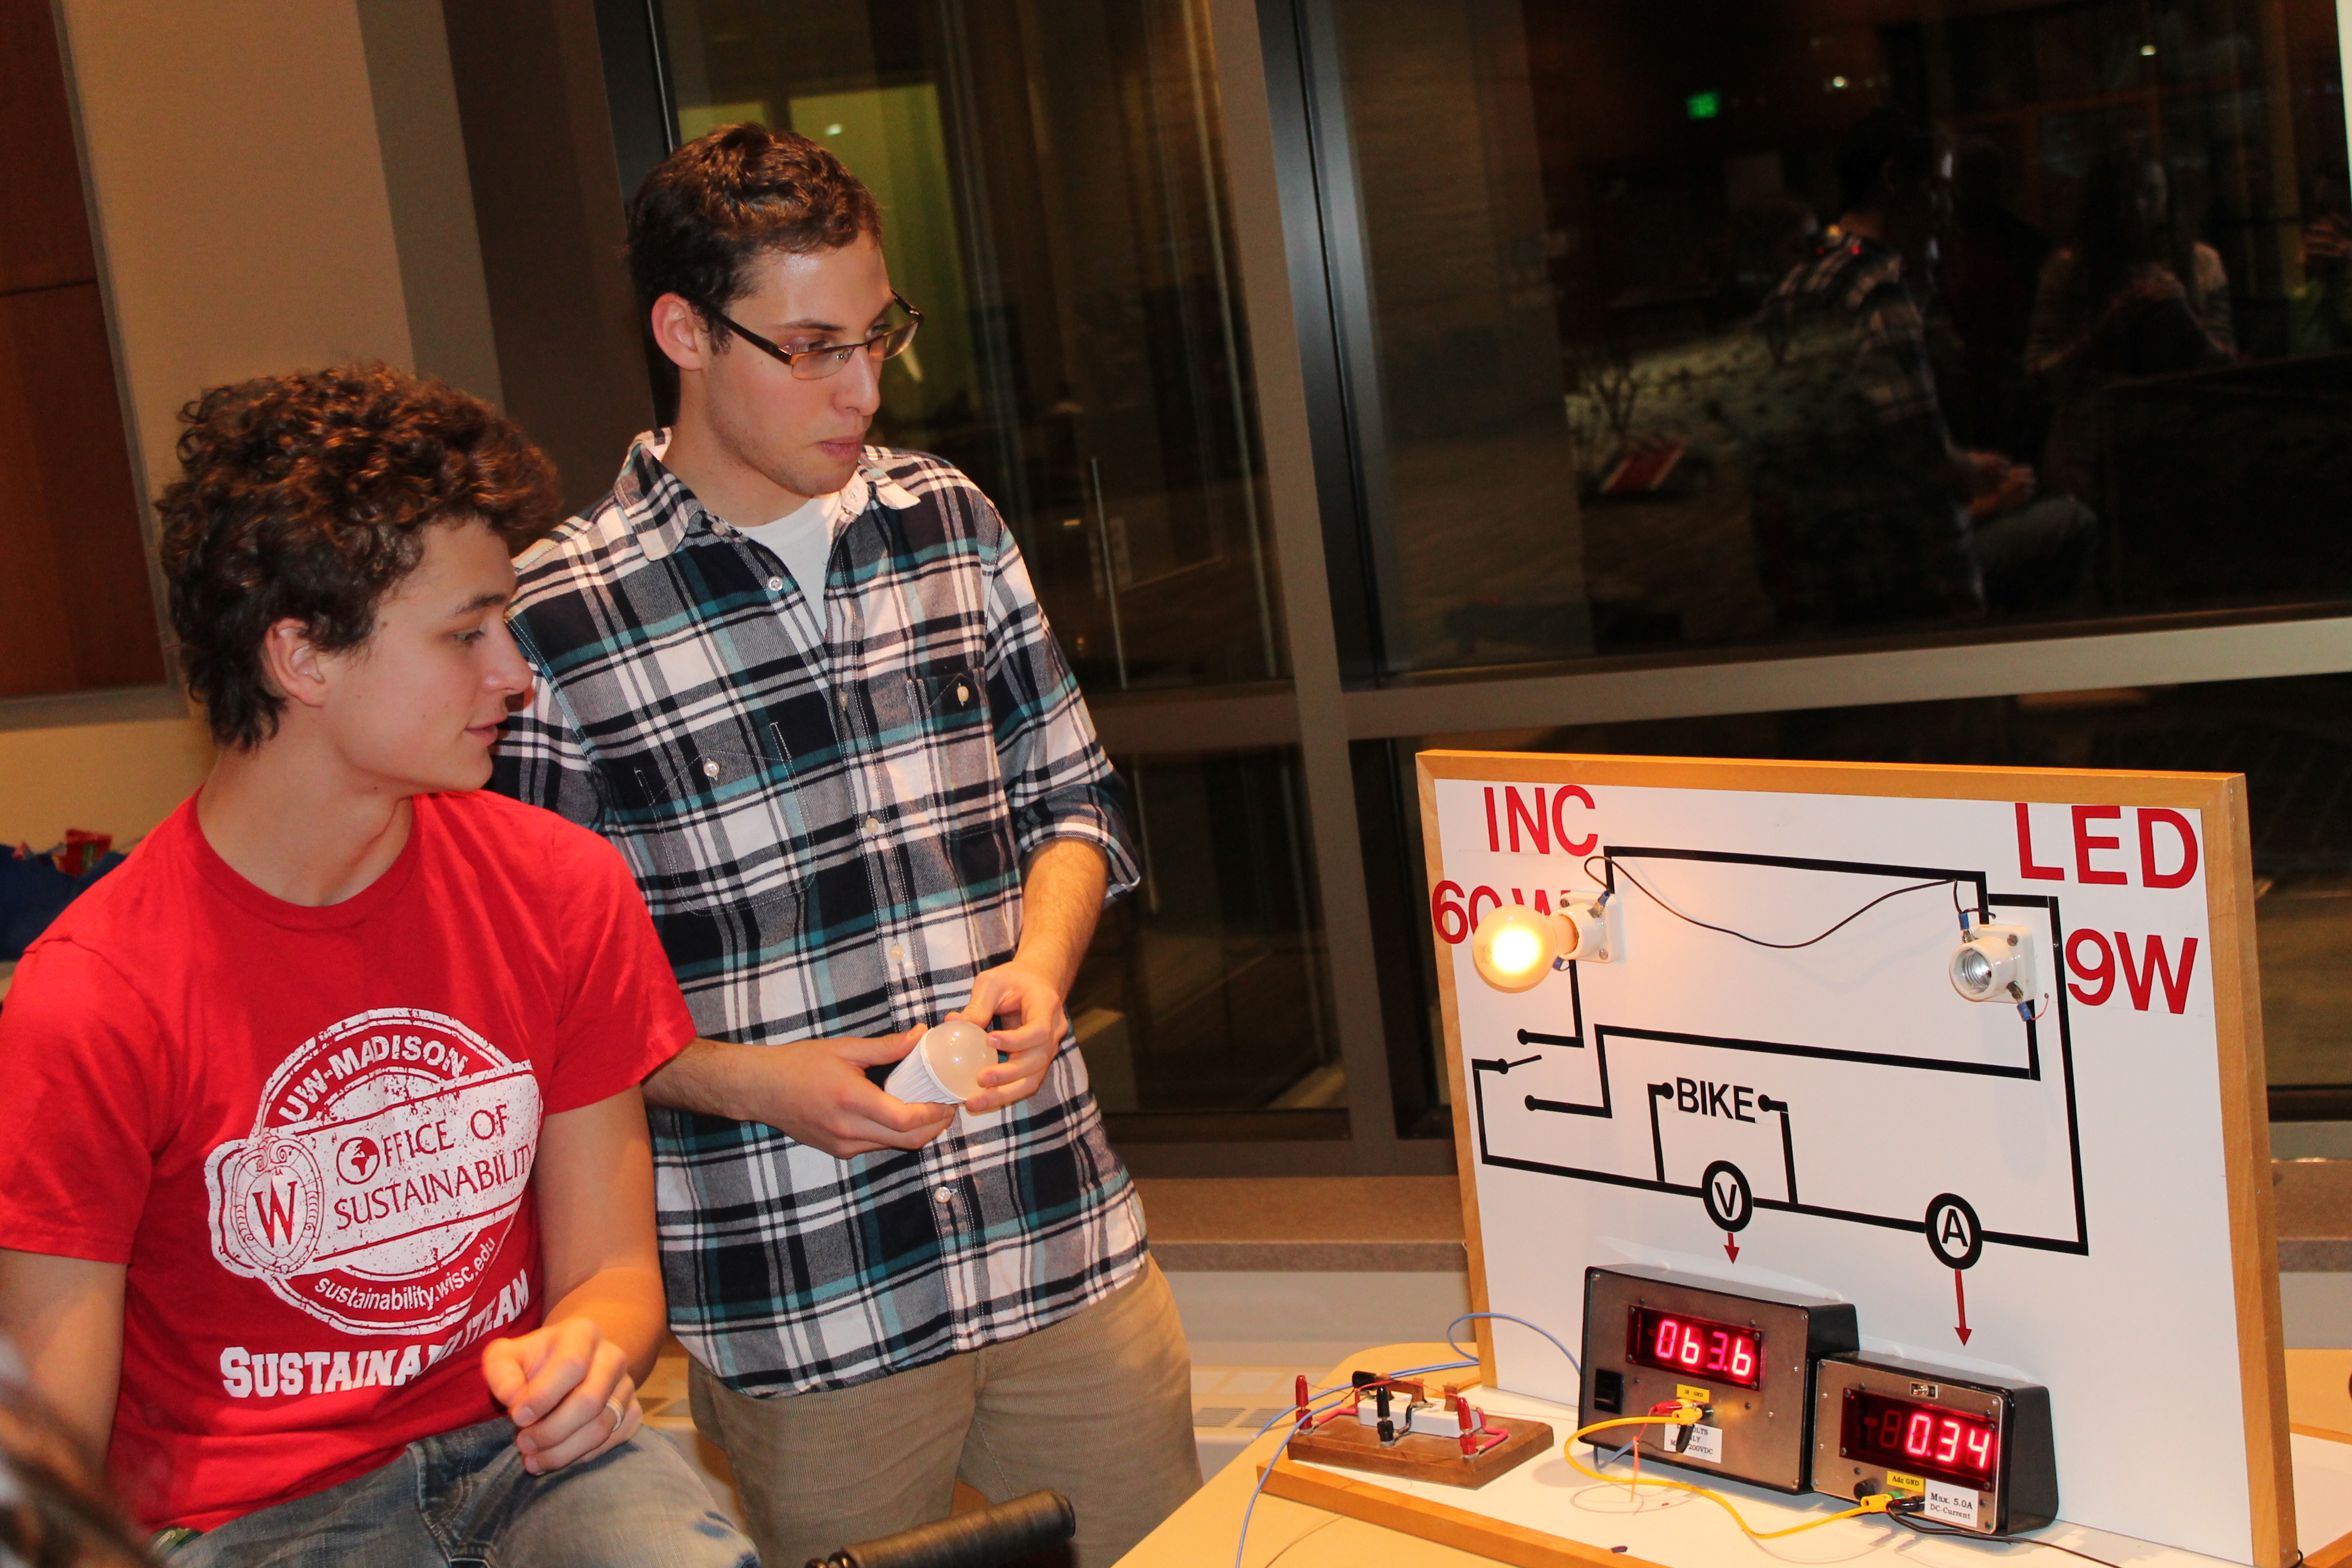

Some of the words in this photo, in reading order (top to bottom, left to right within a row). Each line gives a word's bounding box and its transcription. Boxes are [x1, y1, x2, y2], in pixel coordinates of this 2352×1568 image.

[1484, 785, 1598, 857] INC
[2015, 802, 2198, 889] LED
[2065, 928, 2198, 1015] 9W
[278, 1035, 469, 1122] UW-MADISON
[1676, 1077, 1756, 1124] BIKE
[470, 1103, 508, 1140] OF
[334, 1139, 537, 1231] SUSTAINABILITY
[1714, 1182, 1738, 1218] V
[252, 1178, 298, 1248] W
[1941, 1208, 1969, 1247] A
[315, 1237, 496, 1311] sustainability.wisc.edu
[1907, 1414, 1990, 1468] 0.34
[1906, 1478, 1920, 1487] GND
[1930, 1492, 1950, 1504] Max.
[1953, 1498, 1973, 1510] 5.0A
[1930, 1503, 1972, 1520] DC-Current
